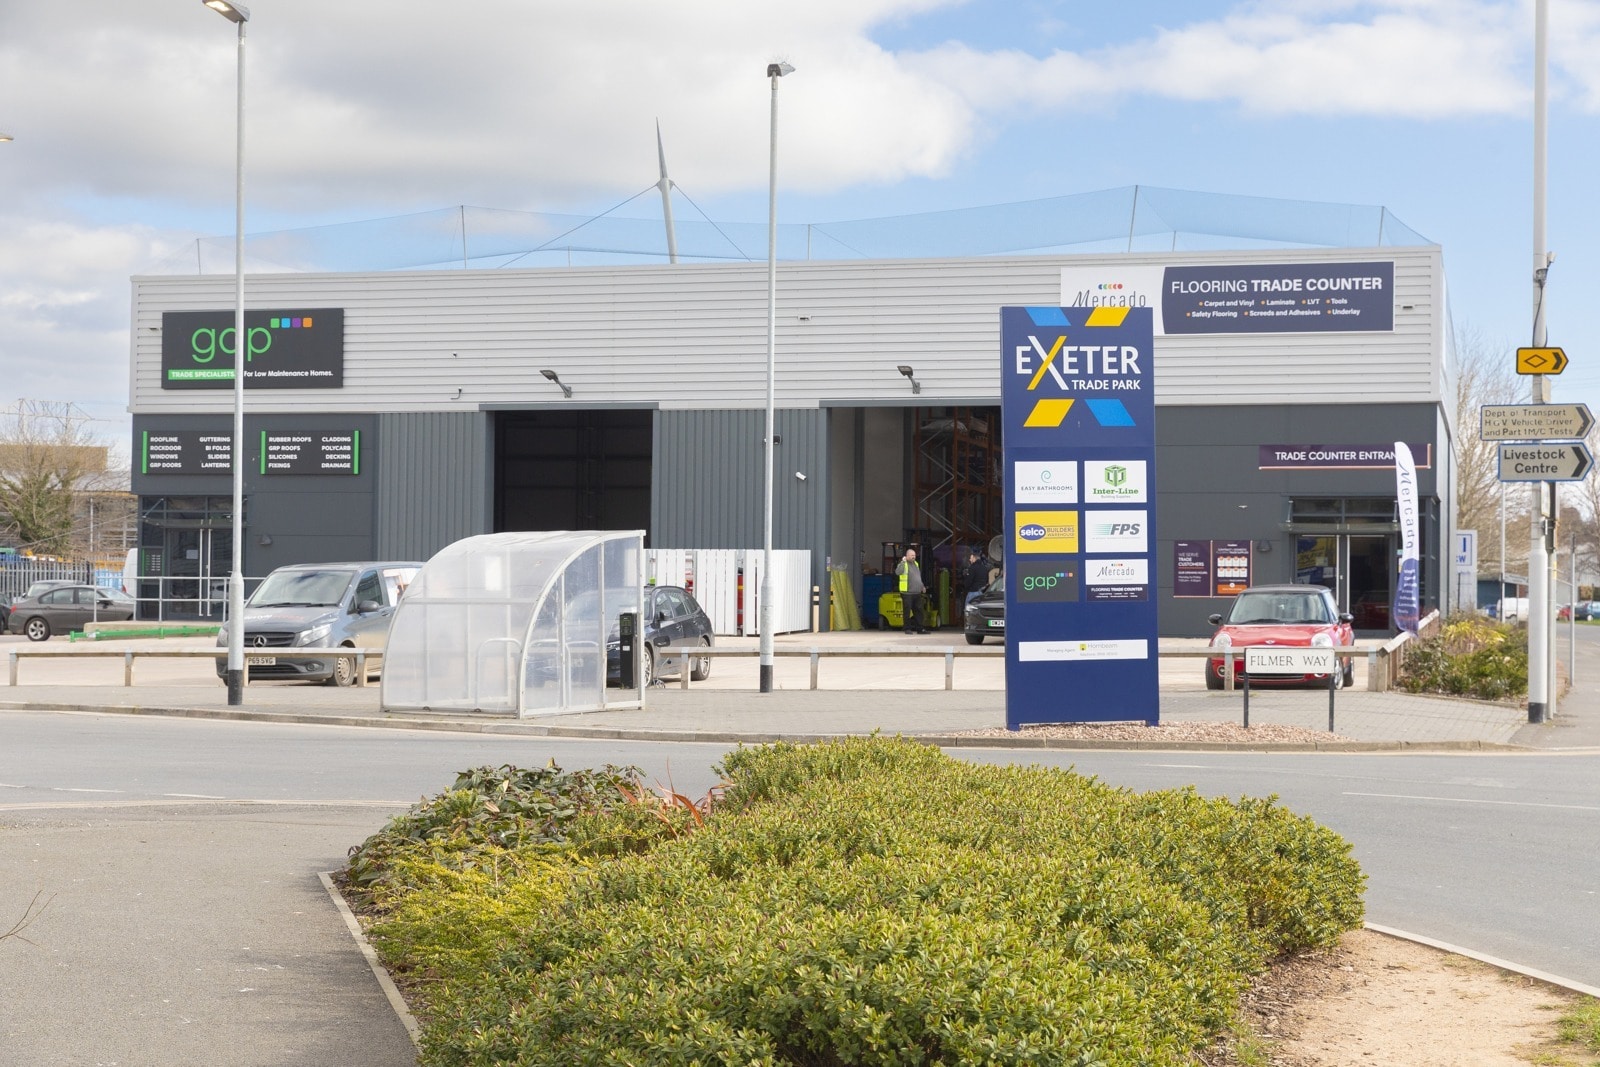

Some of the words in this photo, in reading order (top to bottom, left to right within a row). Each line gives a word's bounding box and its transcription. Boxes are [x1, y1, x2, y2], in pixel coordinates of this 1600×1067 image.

[1171, 280, 1247, 294] FLOORING
[1251, 279, 1302, 292] TRADE
[1306, 277, 1382, 291] COUNTER
[1072, 289, 1146, 307] Mercado
[1289, 308, 1321, 316] Adhesives
[1332, 308, 1361, 316] Underlay
[1016, 336, 1142, 390] EXETER
[1072, 380, 1109, 389] TRADE
[1112, 380, 1141, 389] PARK
[1503, 428, 1522, 436] Part
[1275, 451, 1306, 460] TRADE
[1308, 451, 1357, 460] COUNTER
[1359, 450, 1396, 460] ENTRAN
[1504, 449, 1566, 460] Livestock
[1514, 463, 1558, 473] Centre
[1020, 528, 1045, 536] selco
[1110, 523, 1140, 535] FPS
[1096, 566, 1135, 577] Mercado
[1024, 575, 1057, 590] gap
[1251, 656, 1294, 666] FILMER
[1303, 656, 1328, 666] WAY
